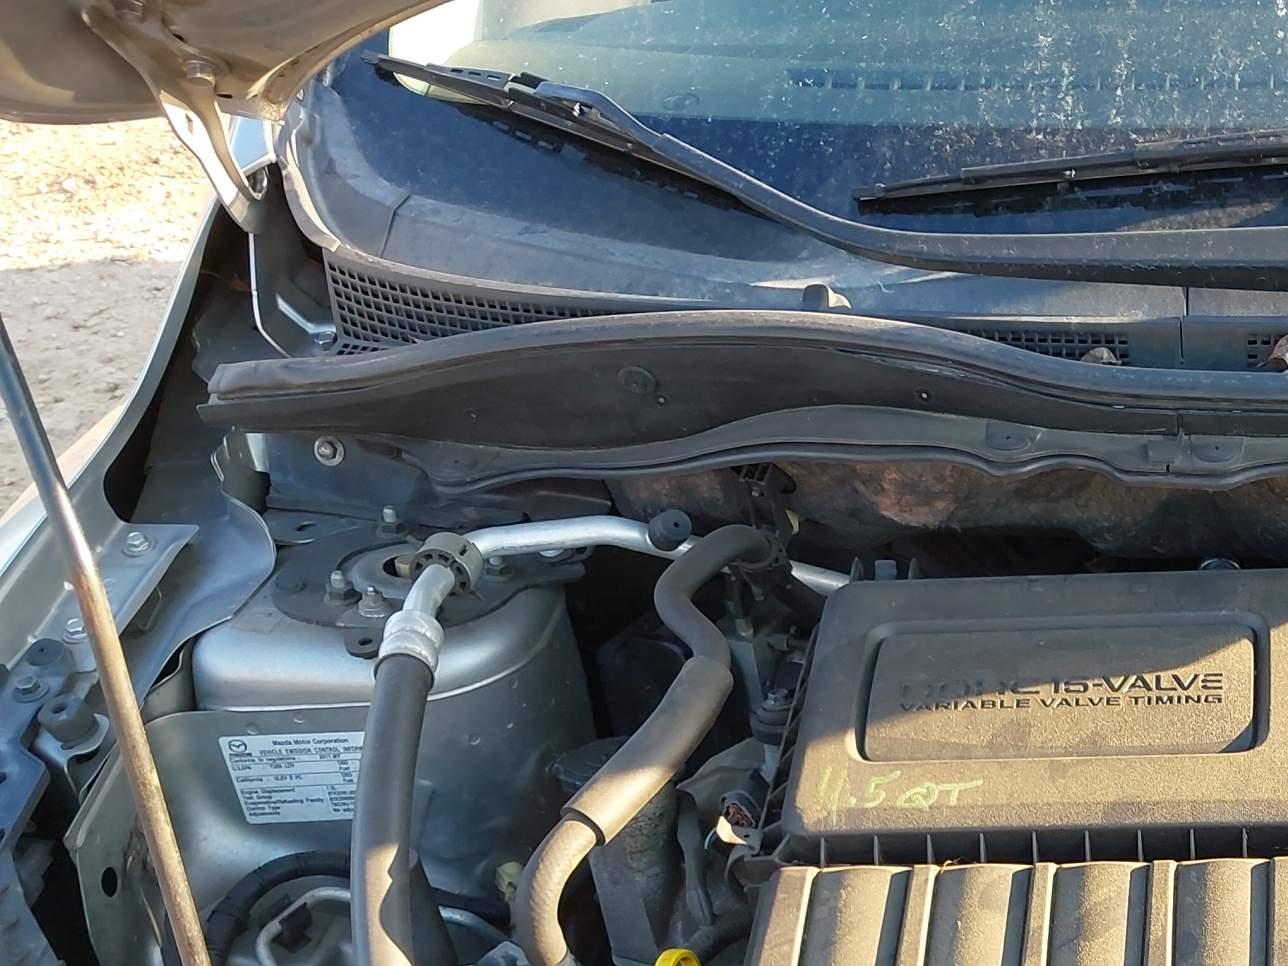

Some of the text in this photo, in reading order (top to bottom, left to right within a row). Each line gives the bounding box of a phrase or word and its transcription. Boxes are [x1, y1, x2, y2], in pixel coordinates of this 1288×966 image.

[901, 693, 1223, 713] VARIABLE VALVE TIMING
